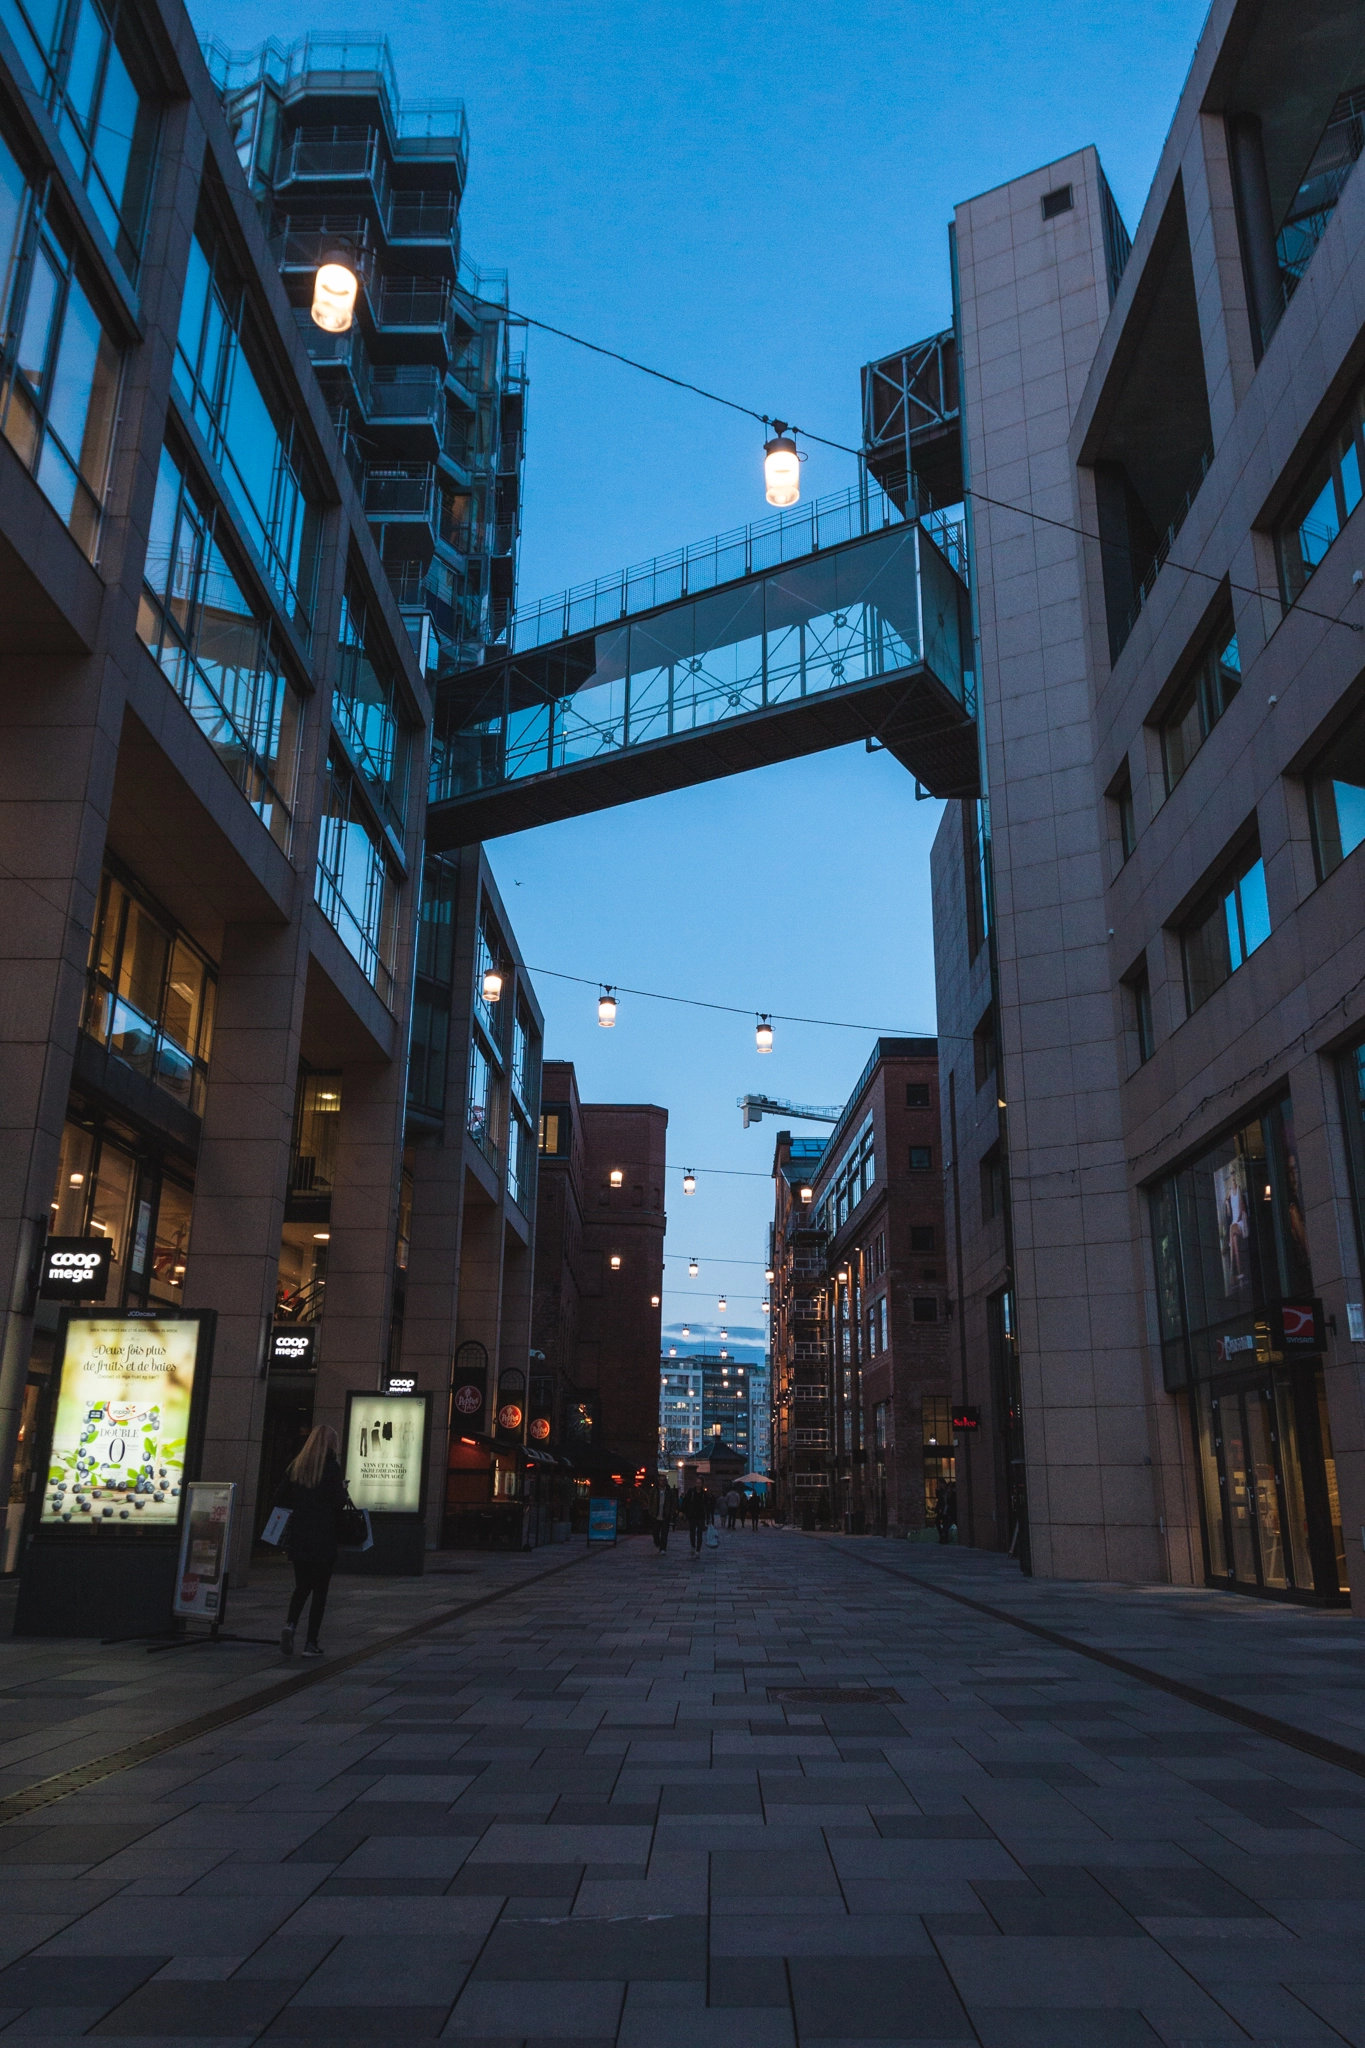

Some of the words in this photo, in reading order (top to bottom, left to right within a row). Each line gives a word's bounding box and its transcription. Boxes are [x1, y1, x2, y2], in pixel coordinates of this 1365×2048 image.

[50, 1252, 102, 1269] coop
[48, 1268, 94, 1283] mega
[275, 1337, 309, 1348] coop
[92, 1344, 125, 1358] Deux
[121, 1344, 144, 1363] fois
[146, 1345, 166, 1356] plus
[274, 1348, 305, 1358] mega
[83, 1360, 96, 1371] de
[94, 1360, 124, 1374] fruits
[126, 1362, 135, 1371] et
[137, 1361, 149, 1371] de
[150, 1358, 177, 1372] baies
[389, 1379, 415, 1388] coop
[100, 1428, 140, 1438] DOUBLE
